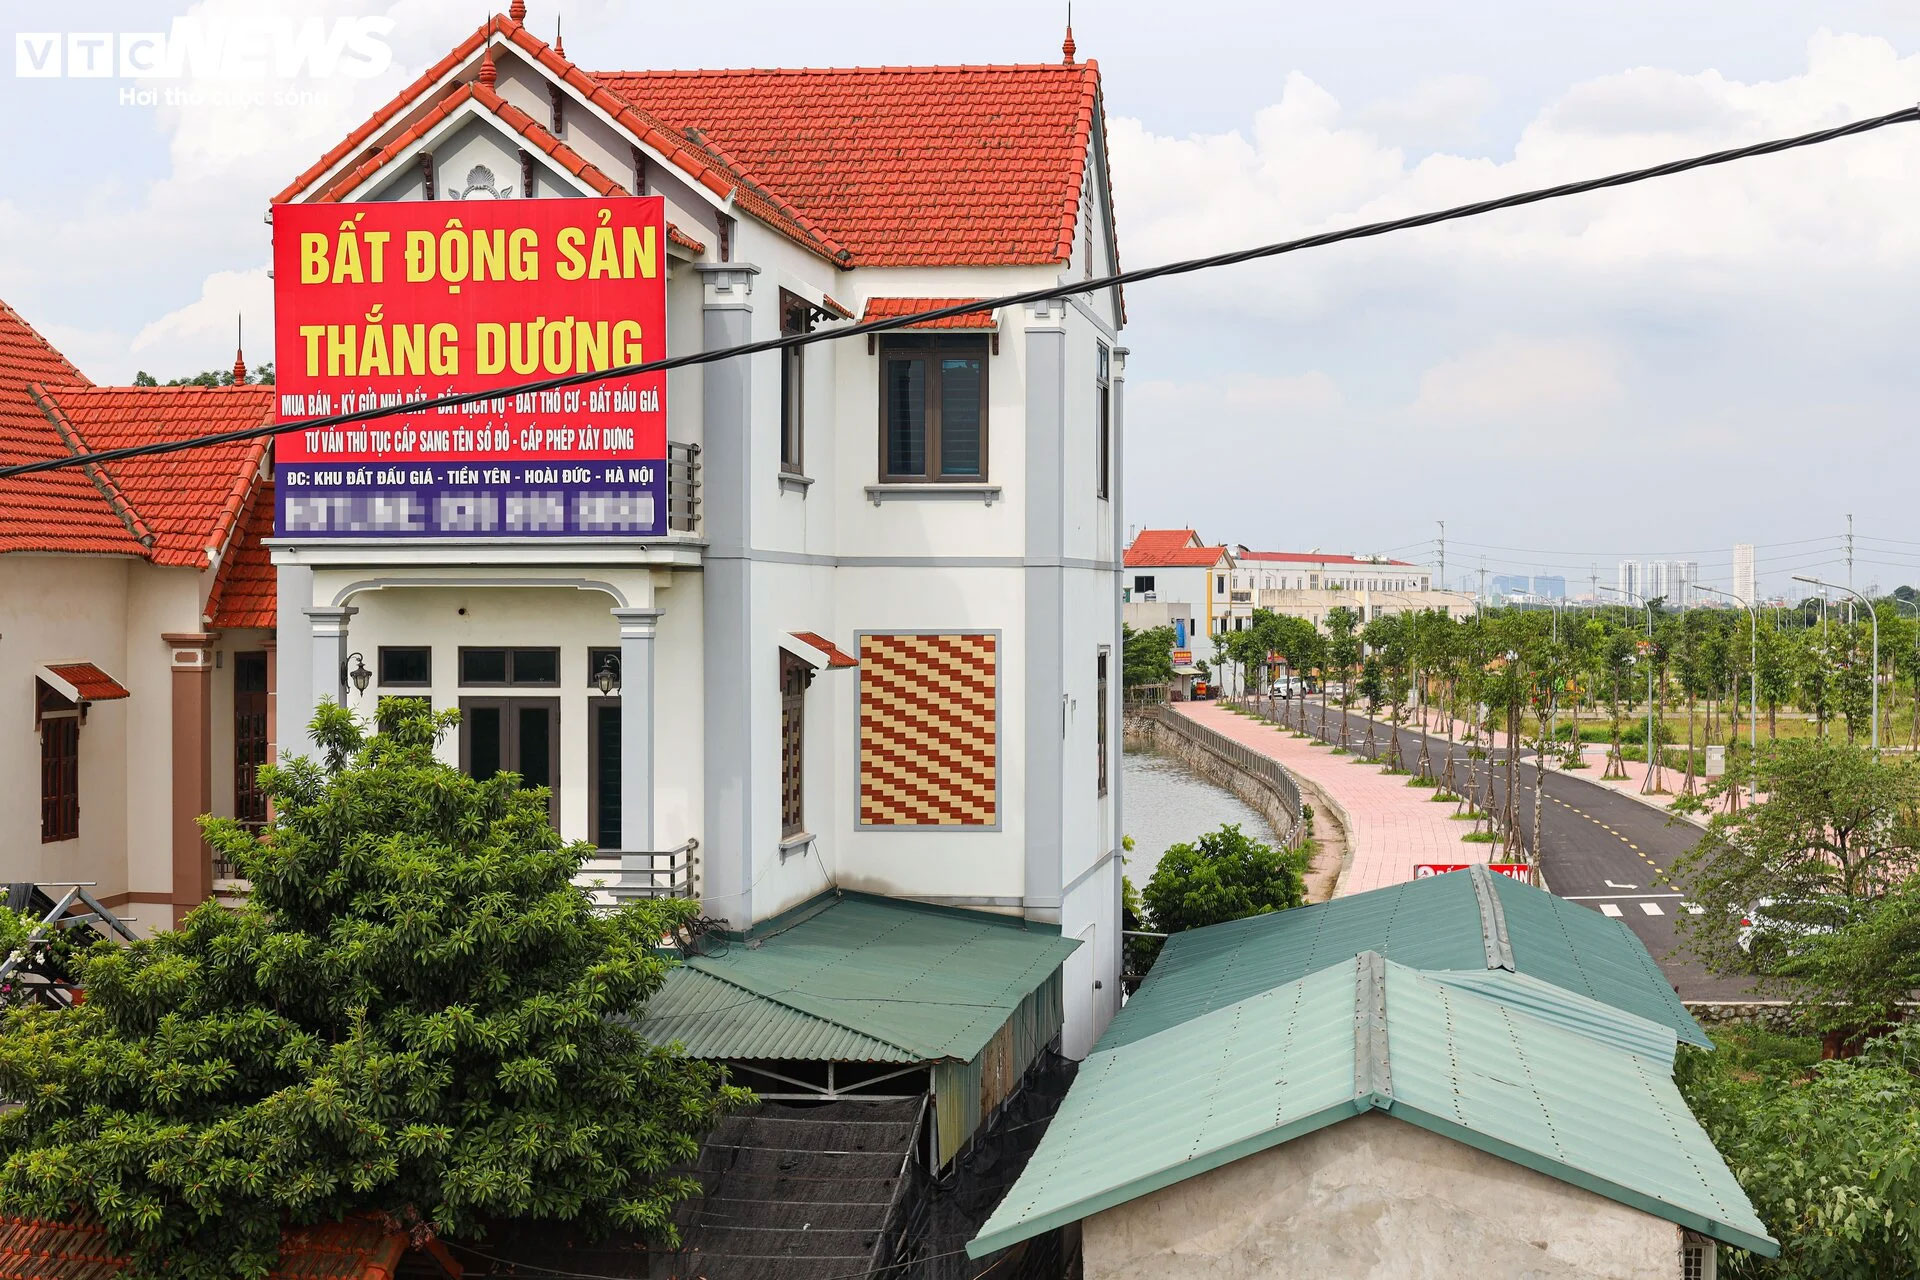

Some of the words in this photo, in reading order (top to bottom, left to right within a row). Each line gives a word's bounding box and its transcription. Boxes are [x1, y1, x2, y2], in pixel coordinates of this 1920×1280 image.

[299, 212, 391, 285] BẤT
[404, 217, 540, 295] ĐỘNG
[555, 208, 657, 281] SẢN
[299, 303, 459, 377] THẮNG
[476, 316, 643, 375] DƯƠNG
[281, 394, 305, 416] MUA
[308, 389, 331, 416] BÁN
[341, 389, 355, 415] KÝ
[491, 396, 505, 419] VỤ
[564, 389, 580, 413] CƯ
[589, 383, 611, 412] ĐẤT
[614, 383, 636, 412] ĐẤU
[639, 385, 660, 412] GIÁ
[305, 429, 320, 453] TƯ
[321, 424, 344, 453] VẤN
[346, 423, 368, 453] THỦ
[370, 430, 391, 457] TỤC
[394, 423, 417, 453] CẤP
[419, 429, 450, 452] SANG
[452, 425, 474, 452] TÊN
[476, 421, 493, 452] SỔ
[494, 422, 510, 452] ĐỎ
[520, 421, 543, 451] CẤP
[545, 424, 575, 451] PHÉP
[577, 423, 600, 451] XÂY
[603, 426, 634, 455] DỰNG
[287, 471, 310, 486] ĐC:
[314, 471, 343, 486] KHU
[346, 466, 373, 485] ĐẤT
[377, 466, 406, 485] ĐẤU
[409, 467, 434, 485] GIÁ
[447, 465, 479, 484] TIỀN
[482, 467, 511, 484] YÊN
[525, 466, 558, 484] HOÀI
[562, 466, 591, 484] ĐỨC
[605, 465, 625, 483] HÀ
[628, 465, 654, 486] NỘI
